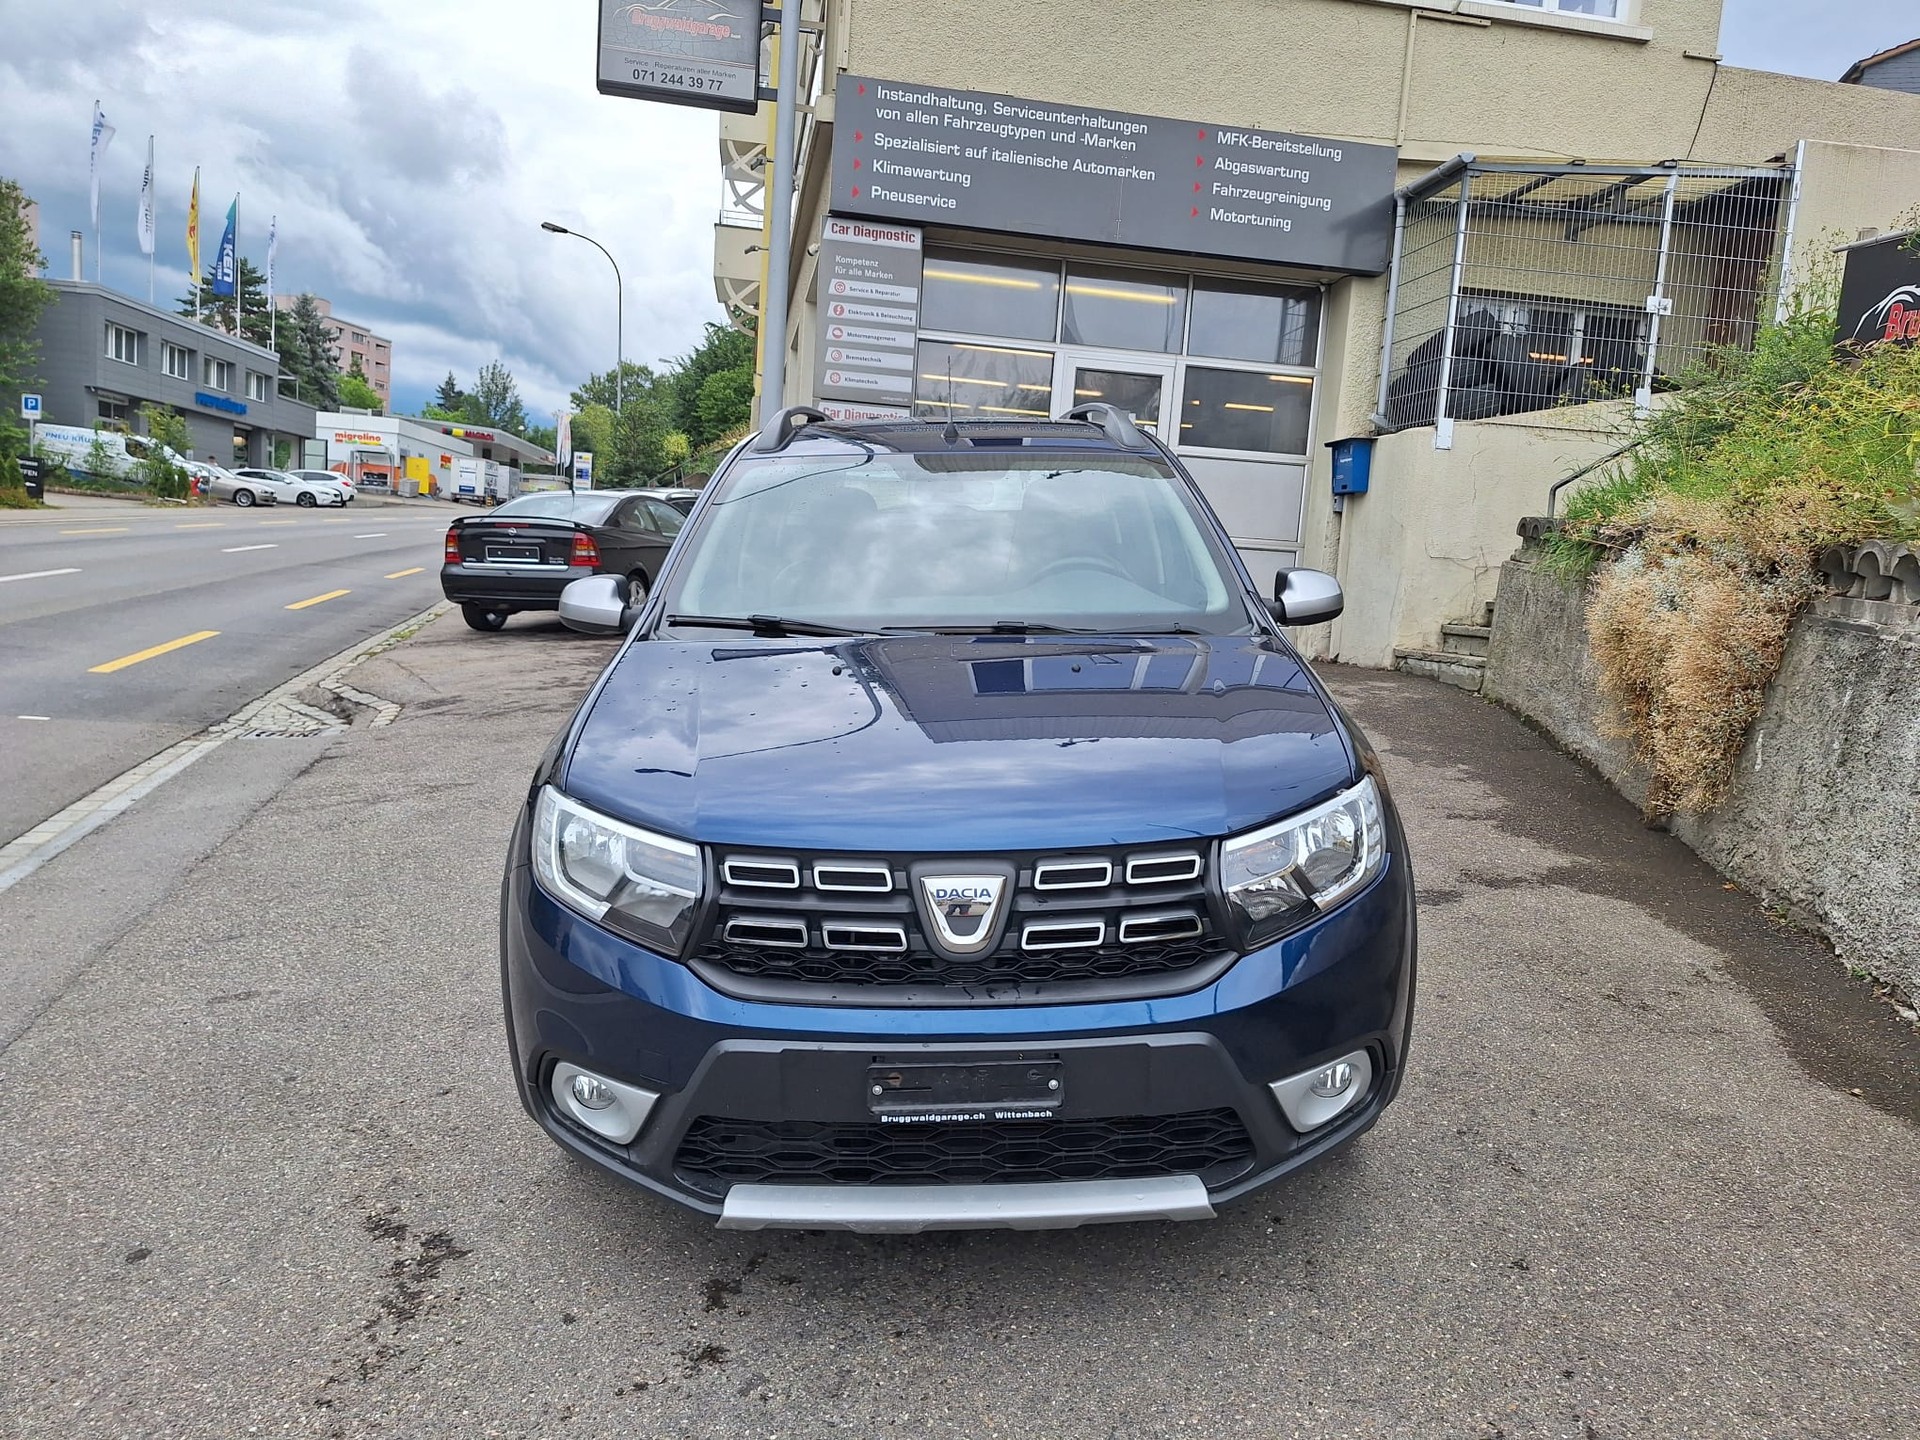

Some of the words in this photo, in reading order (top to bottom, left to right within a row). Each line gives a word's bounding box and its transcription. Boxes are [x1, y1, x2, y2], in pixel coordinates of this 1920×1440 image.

[624, 57, 649, 67] Service
[632, 68, 655, 83] 071
[660, 72, 684, 87] 244
[688, 76, 704, 89] 39
[708, 78, 724, 92] 77
[877, 85, 987, 115] Instandhaltung,
[993, 101, 1148, 136] Serviceunterhaltungen
[876, 108, 901, 121] von
[906, 110, 939, 126] allen
[943, 114, 1047, 141] Fahrzeugtypen
[1050, 130, 1076, 145] und
[1080, 134, 1137, 152] -Marken
[874, 132, 961, 157] Spezialisiert
[965, 145, 988, 161] auf
[992, 147, 1068, 171] italienische
[1072, 157, 1156, 182] Automarken
[1217, 131, 1343, 162] MFK-Bereitstellung
[873, 159, 972, 187] Klimawartung
[1214, 157, 1310, 183] Abgaswartung
[871, 186, 957, 209] Pneuservice
[1212, 183, 1332, 211] Fahrzeugreinigung
[1210, 207, 1292, 232] Motortuning
[831, 223, 850, 235] Car
[853, 225, 915, 244] Diagnostic
[835, 255, 879, 267] Kompetenz
[835, 266, 847, 275] für
[849, 268, 863, 276] alle
[864, 270, 893, 280] Marken
[849, 286, 869, 294] Service
[1884, 303, 1920, 341] Bru
[27, 398, 36, 409] P
[823, 407, 842, 419] Car
[335, 431, 382, 442] migrolino
[936, 888, 992, 898] DACIA
[881, 1113, 986, 1123] Bruggwaldgarage.ch
[995, 1110, 1053, 1120] Wittenbach
